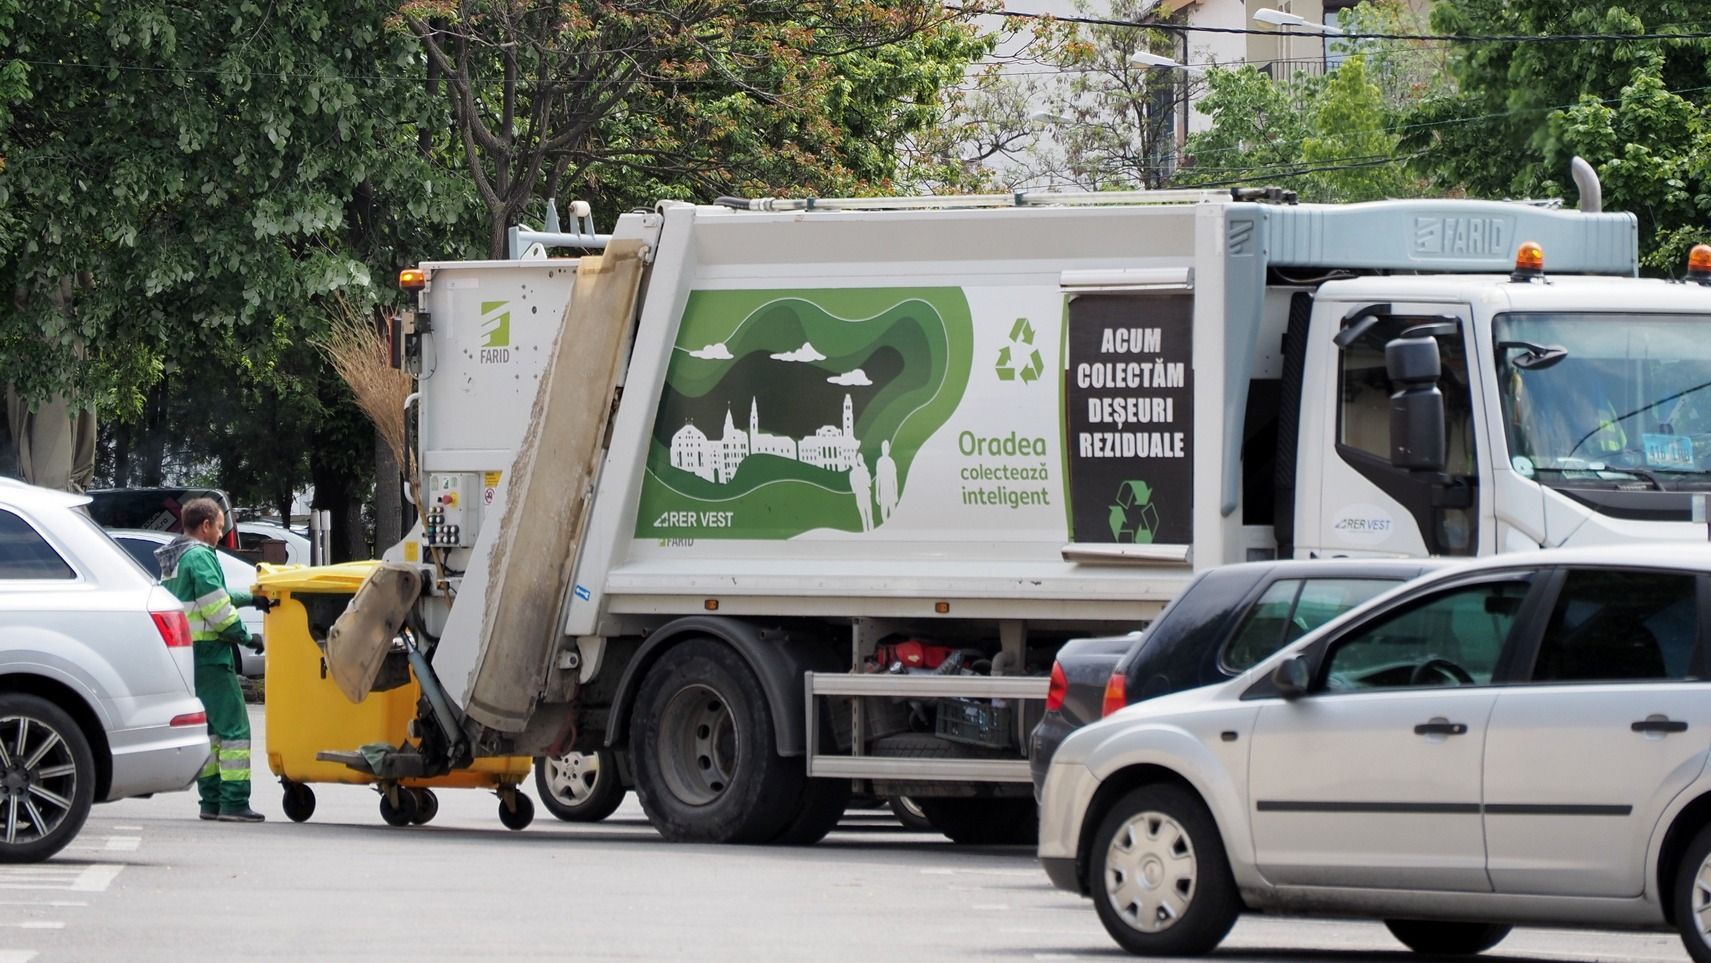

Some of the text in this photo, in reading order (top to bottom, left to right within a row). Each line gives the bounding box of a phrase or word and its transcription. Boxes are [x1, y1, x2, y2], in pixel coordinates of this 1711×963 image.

[1441, 218, 1504, 254] FARID
[1101, 328, 1161, 353] ACUM
[480, 349, 510, 364] FARID
[1077, 358, 1184, 388] COLECTĂM
[958, 430, 1047, 456] Oradea
[1079, 432, 1184, 458] REZIDUALE
[960, 462, 1048, 480] colectează
[962, 486, 1050, 509] inteligent
[700, 512, 733, 527] VEST
[1367, 520, 1391, 531] VEST
